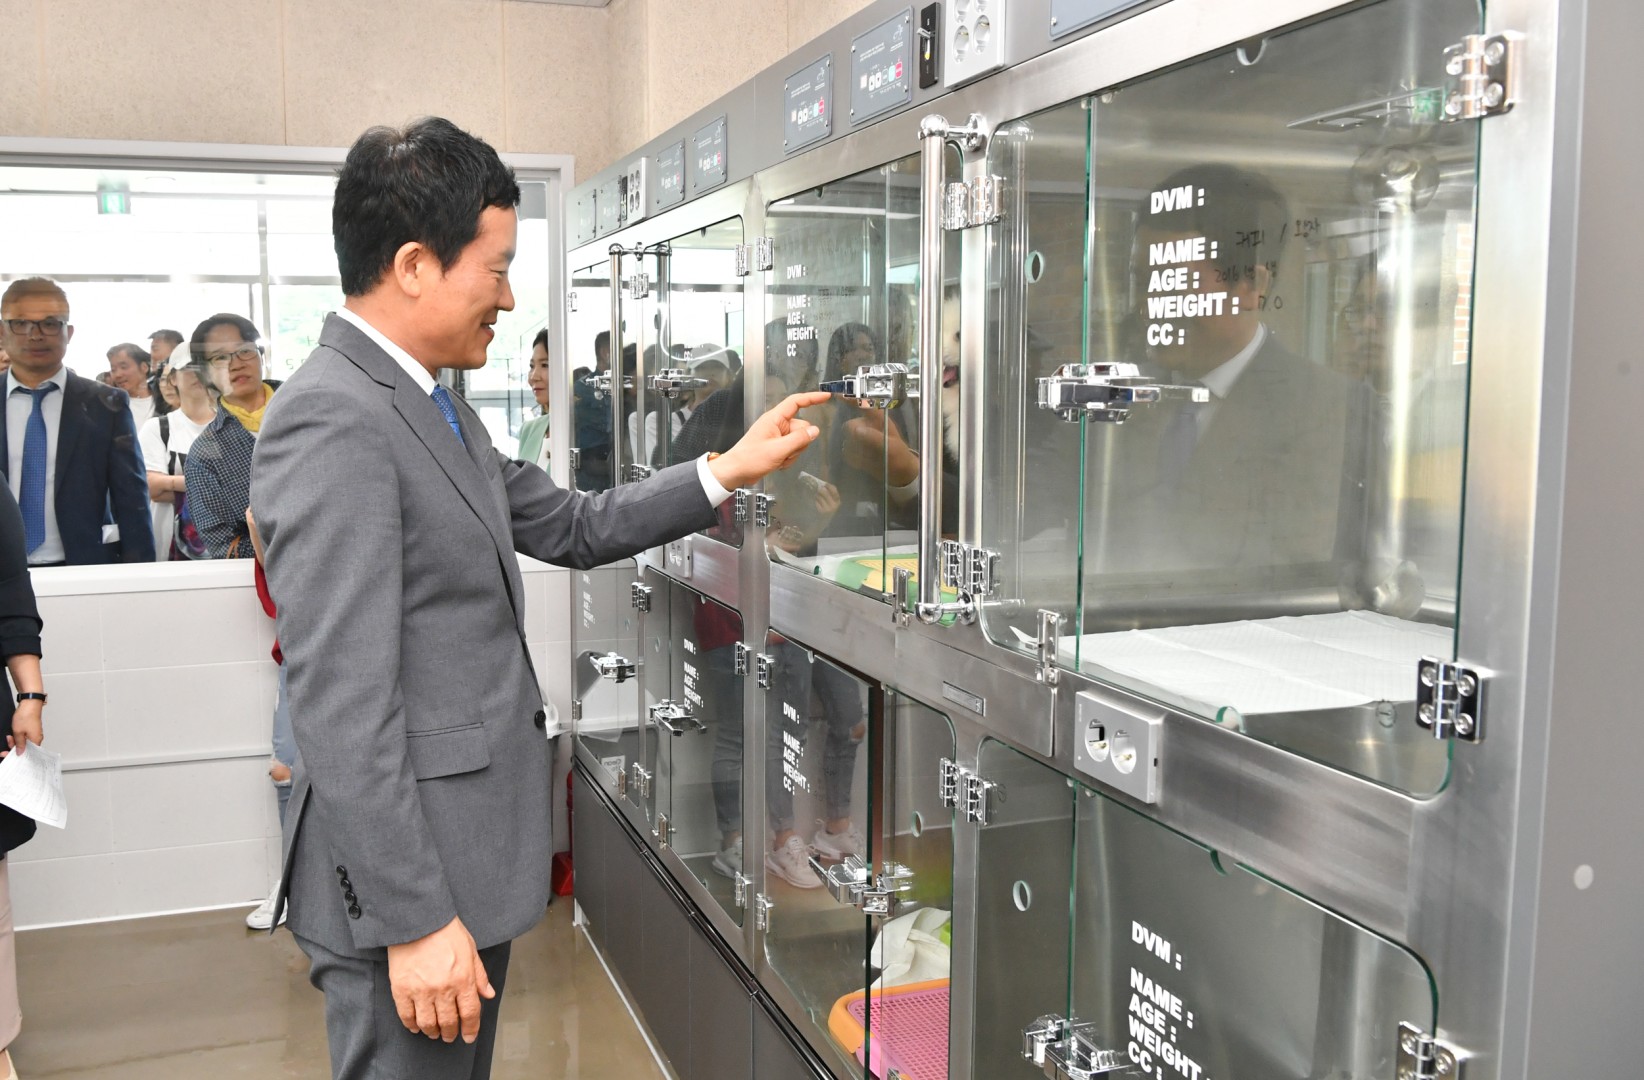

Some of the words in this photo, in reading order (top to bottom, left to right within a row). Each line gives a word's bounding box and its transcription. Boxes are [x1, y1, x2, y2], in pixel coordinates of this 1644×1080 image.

[1151, 185, 1193, 214] DVM
[1150, 237, 1206, 265] NAME
[786, 264, 802, 280] DVM
[1147, 267, 1188, 293] AGE
[786, 294, 807, 310] NAME
[1147, 292, 1228, 319] WEIGHT
[786, 311, 801, 326] AGE
[786, 325, 815, 341] WEIGHT
[1147, 323, 1174, 346] CC
[786, 343, 797, 357] CC
[783, 701, 797, 722] DVM
[783, 730, 801, 755] NAME
[783, 746, 796, 766] AGE
[783, 760, 807, 790] WEIGHT
[783, 775, 792, 792] CC
[1131, 920, 1171, 964] DVM
[1130, 967, 1182, 1021] NAME
[1128, 993, 1166, 1035] AGE
[1128, 1014, 1202, 1080] WEIGHT
[1128, 1041, 1152, 1073] CC
